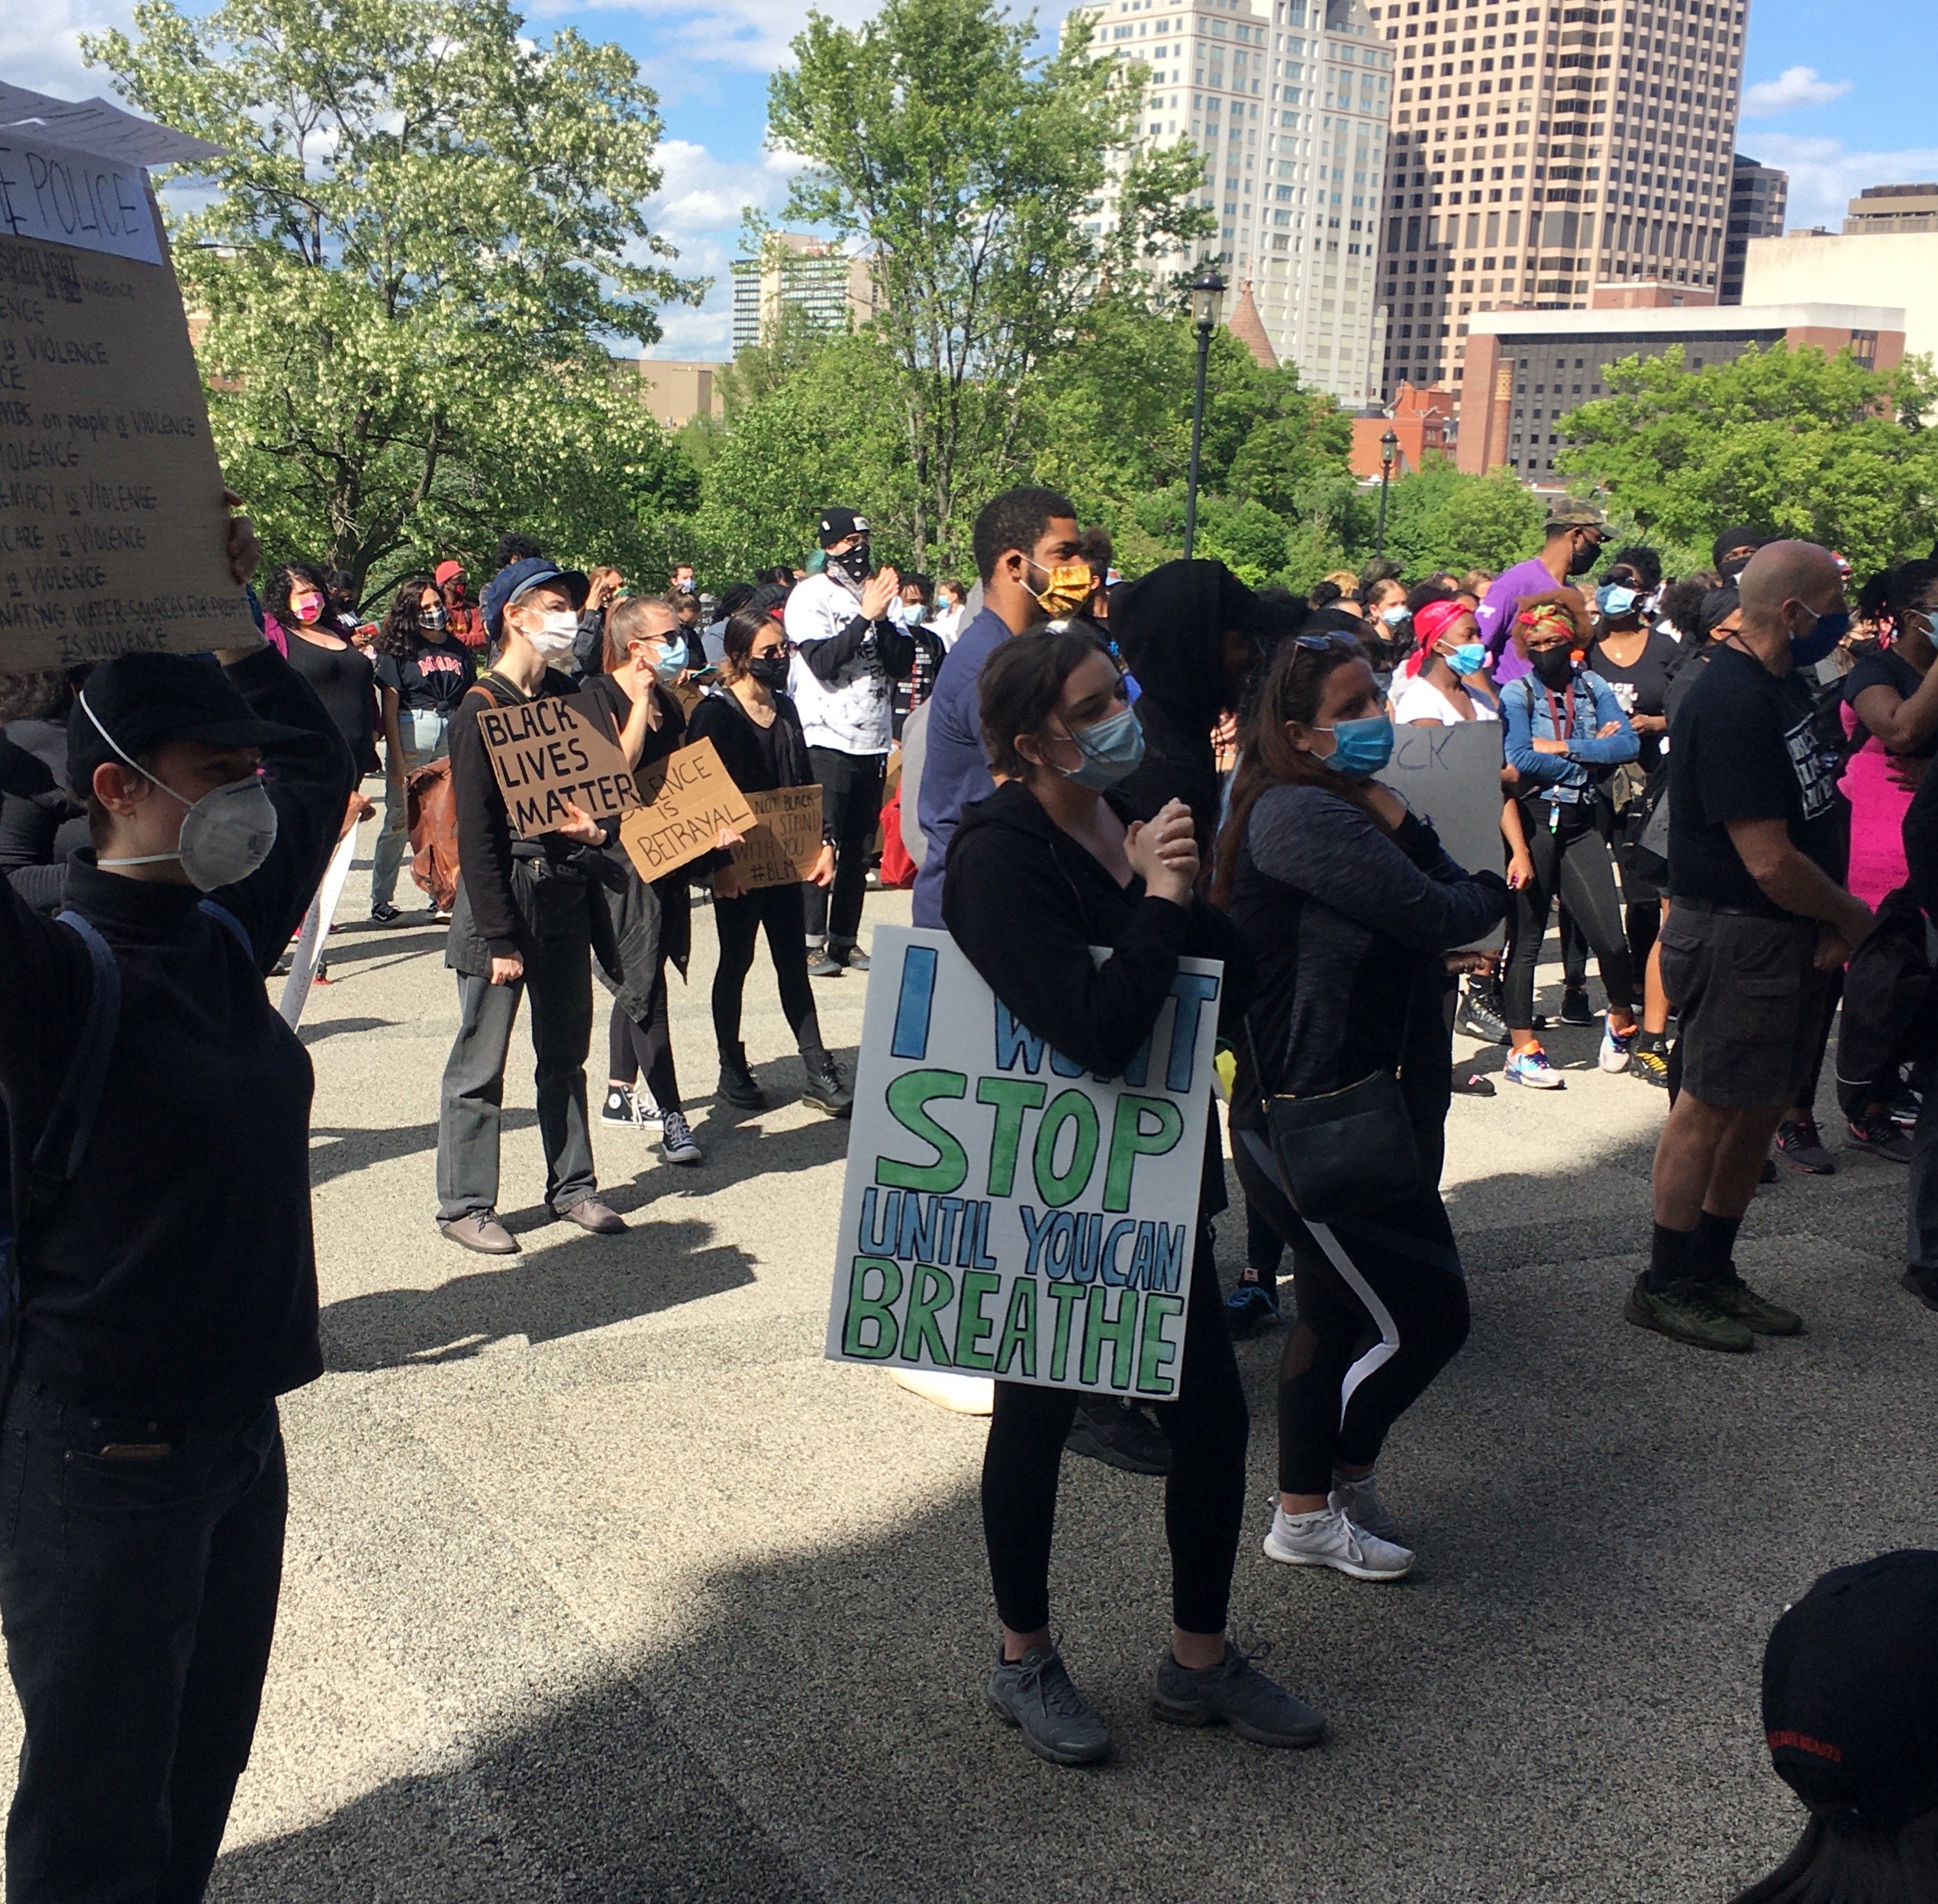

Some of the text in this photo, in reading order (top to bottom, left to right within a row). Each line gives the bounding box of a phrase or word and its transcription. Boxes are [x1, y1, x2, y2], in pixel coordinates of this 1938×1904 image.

[25, 152, 139, 239] POLICE
[25, 333, 108, 366] VIOLENCE
[130, 408, 196, 437] VIOLENCE
[82, 480, 158, 512] VIOLENCE
[74, 522, 147, 553] VIOLENCE
[27, 565, 106, 592] VIOLENCE
[73, 596, 126, 628] WATER
[188, 594, 211, 620] FOR
[56, 627, 167, 657] IS VIOLENCE
[483, 699, 579, 747] BLACK
[498, 737, 589, 788] LIVES
[515, 773, 643, 833] MATTER
[656, 800, 679, 820] IS
[754, 792, 814, 814] NOT BLACK
[637, 804, 750, 868] BETRAYAL
[779, 810, 821, 836] STAND
[734, 836, 805, 861] WITH YOU
[750, 859, 798, 881] #BLM
[890, 943, 939, 1061] I
[874, 1068, 1185, 1213] STOP
[858, 1186, 997, 1270] UNTIL
[840, 1255, 1185, 1396] BREATHE
